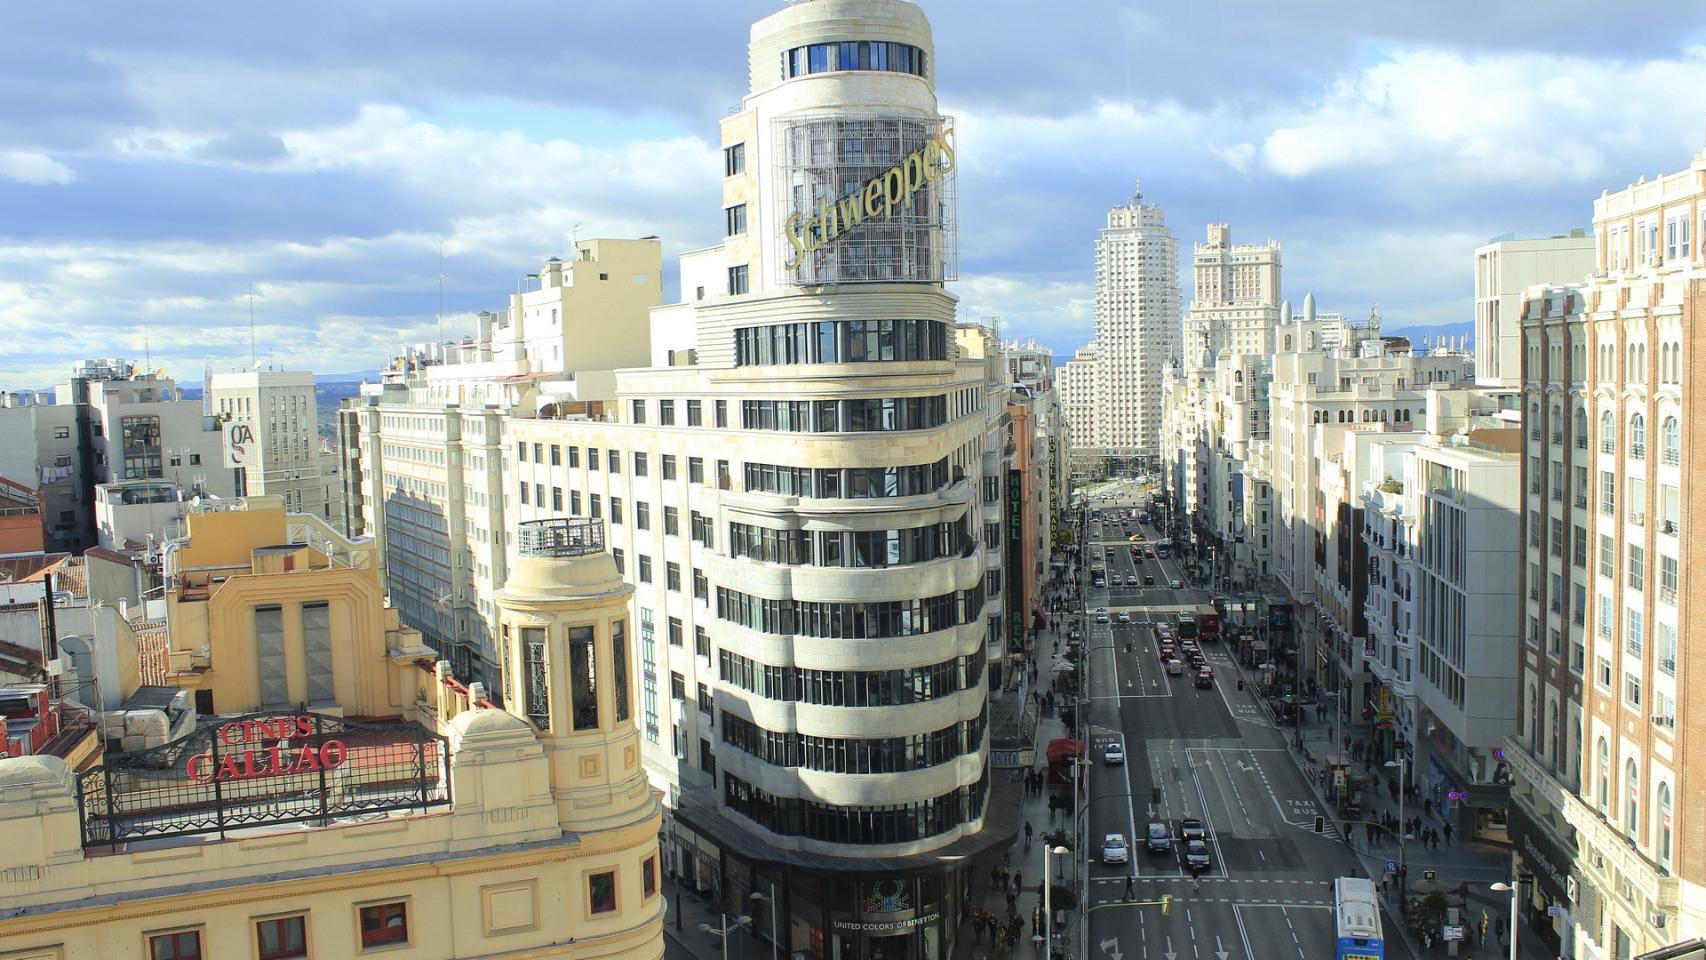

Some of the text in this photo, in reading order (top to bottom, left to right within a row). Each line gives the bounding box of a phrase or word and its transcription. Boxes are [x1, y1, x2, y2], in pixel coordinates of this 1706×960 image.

[785, 127, 955, 271] Schweppes
[1010, 473, 1022, 649] HOTEL REX
[220, 714, 313, 744] CINES
[186, 739, 348, 782] CALLAO
[834, 921, 860, 930] UNITED
[896, 920, 906, 929] OF
